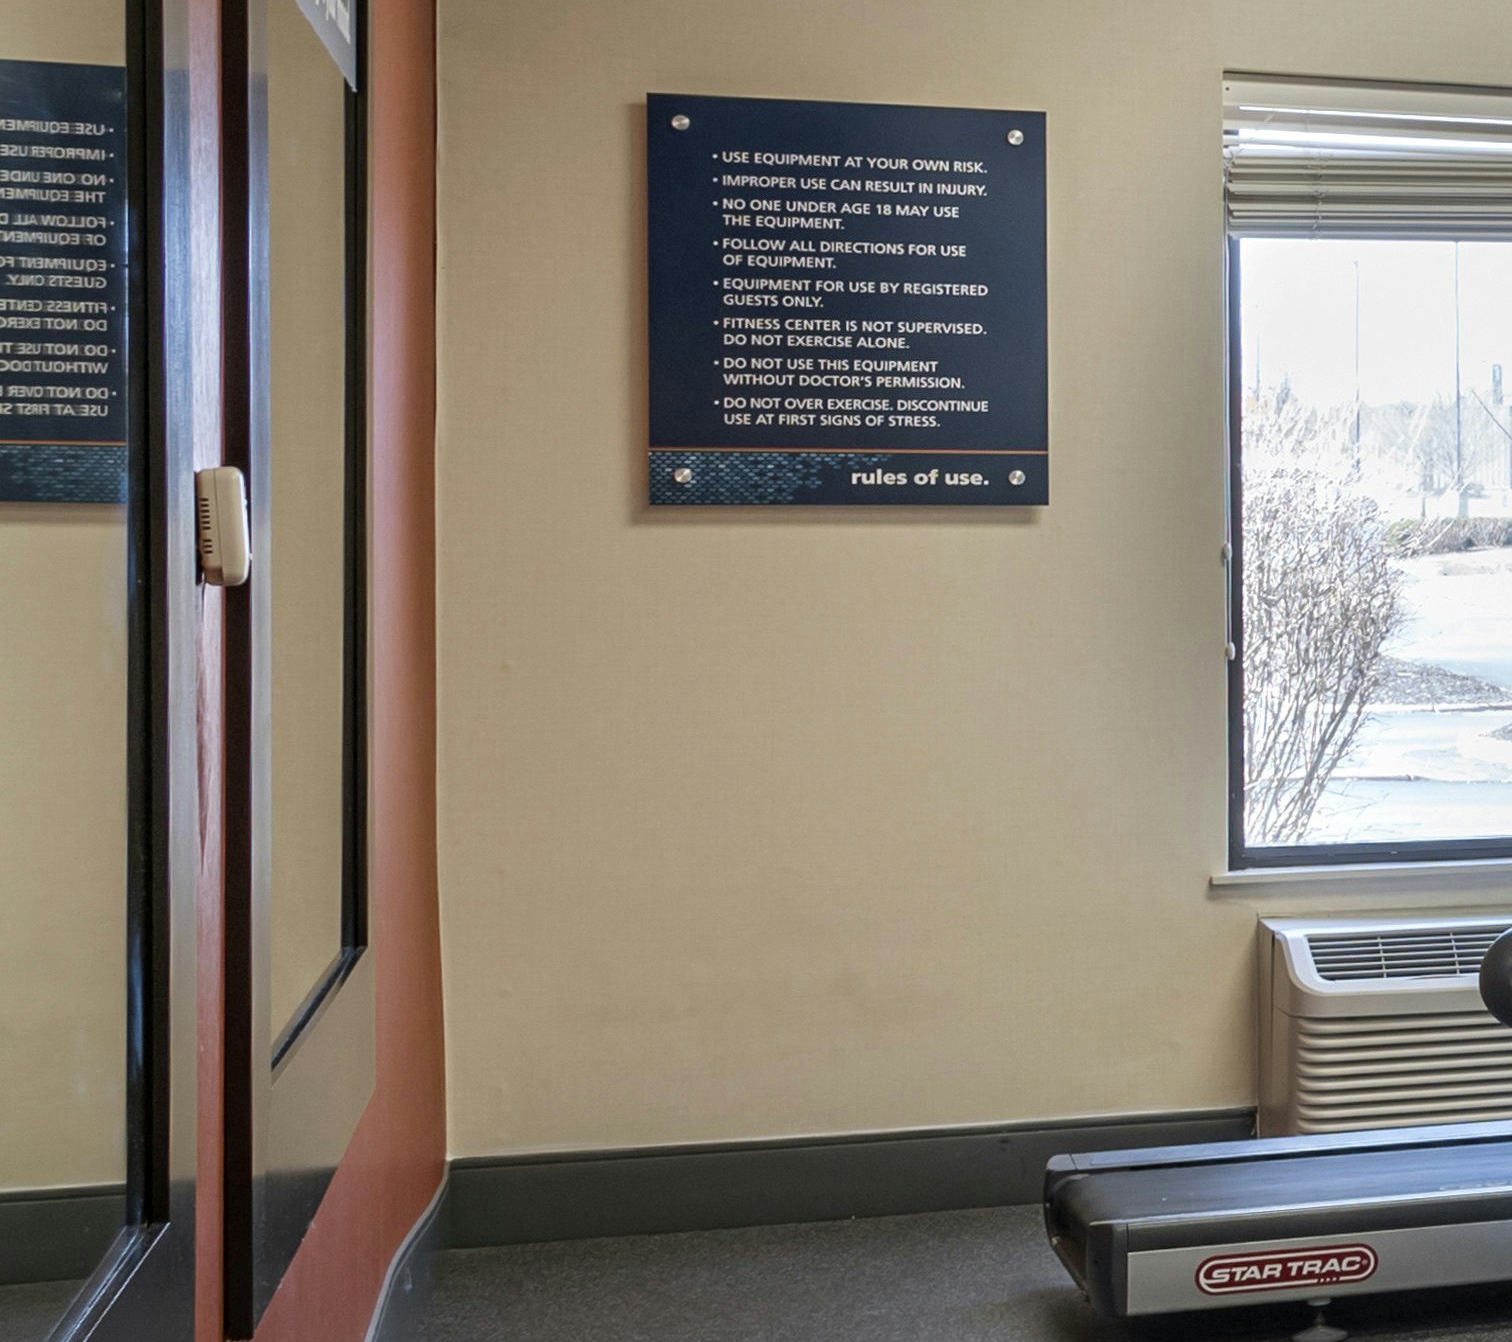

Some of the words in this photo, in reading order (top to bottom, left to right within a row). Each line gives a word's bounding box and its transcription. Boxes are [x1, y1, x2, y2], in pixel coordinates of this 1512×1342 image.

[722, 151, 749, 163] USE
[754, 152, 841, 166] EQUIPMENT
[844, 156, 863, 167] AT
[866, 156, 908, 169] YOUR
[912, 159, 950, 171] OWN
[953, 160, 988, 173] RISK.
[723, 174, 796, 188] IMPROPER
[800, 177, 826, 189] USE
[830, 178, 861, 190] CAN
[865, 180, 915, 193] RESULT
[918, 182, 933, 194] IN
[937, 183, 987, 196] INJURY.
[723, 198, 746, 209] NO
[750, 199, 781, 211] ONE
[786, 200, 837, 213] UNDER
[840, 202, 871, 214] AGE
[876, 203, 892, 215] 18
[896, 204, 930, 216] MAY
[933, 205, 959, 218] USE
[722, 214, 751, 226] THE
[756, 215, 845, 229] EQUIPMENT.
[723, 237, 786, 250] FOLLOW
[789, 240, 816, 251] ALL
[820, 240, 905, 255] DIRECTIONS
[908, 243, 937, 255] FOR
[940, 244, 967, 257] USE
[723, 253, 742, 265] OF
[747, 254, 836, 268] EQUIPMENT.
[723, 277, 811, 290] EQUIPMENT
[816, 280, 844, 292] FOR
[849, 281, 875, 293] USE
[880, 281, 900, 293] BY
[903, 282, 988, 296] REGISTERED
[723, 293, 778, 306] GUESTS
[782, 295, 824, 307] ONLY.
[723, 317, 780, 329] FITNESS
[785, 318, 841, 331] CENTER
[846, 320, 858, 331] IS
[862, 320, 894, 332] NOT
[897, 321, 987, 334] SUPERVISED.
[724, 333, 747, 345] DO
[751, 334, 783, 345] NOT
[787, 334, 852, 347] EXERCISE
[856, 336, 910, 348] ALONE.
[724, 357, 747, 368] DO
[751, 357, 783, 369] NOT
[787, 358, 814, 370] USE
[818, 358, 850, 370] THIS
[854, 359, 939, 372] EQUIPMENT
[723, 373, 795, 385] WITHOUT
[876, 376, 965, 388] PERMISSION.
[724, 396, 747, 408] DO
[750, 397, 781, 408] NOT
[784, 397, 824, 409] OVER
[827, 398, 894, 410] EXERCISE.
[897, 399, 989, 412] DISCONTINUE
[724, 413, 751, 424] USE
[756, 413, 775, 424] AT
[779, 413, 816, 425] FIRST
[820, 414, 861, 426] SIGNS
[865, 414, 884, 426] OF
[888, 415, 941, 427] STRESS.
[852, 468, 908, 484] rules
[914, 468, 939, 484] of
[945, 472, 989, 485] use.
[1211, 1262, 1285, 1284] STAR
[1286, 1256, 1362, 1277] TRAC
